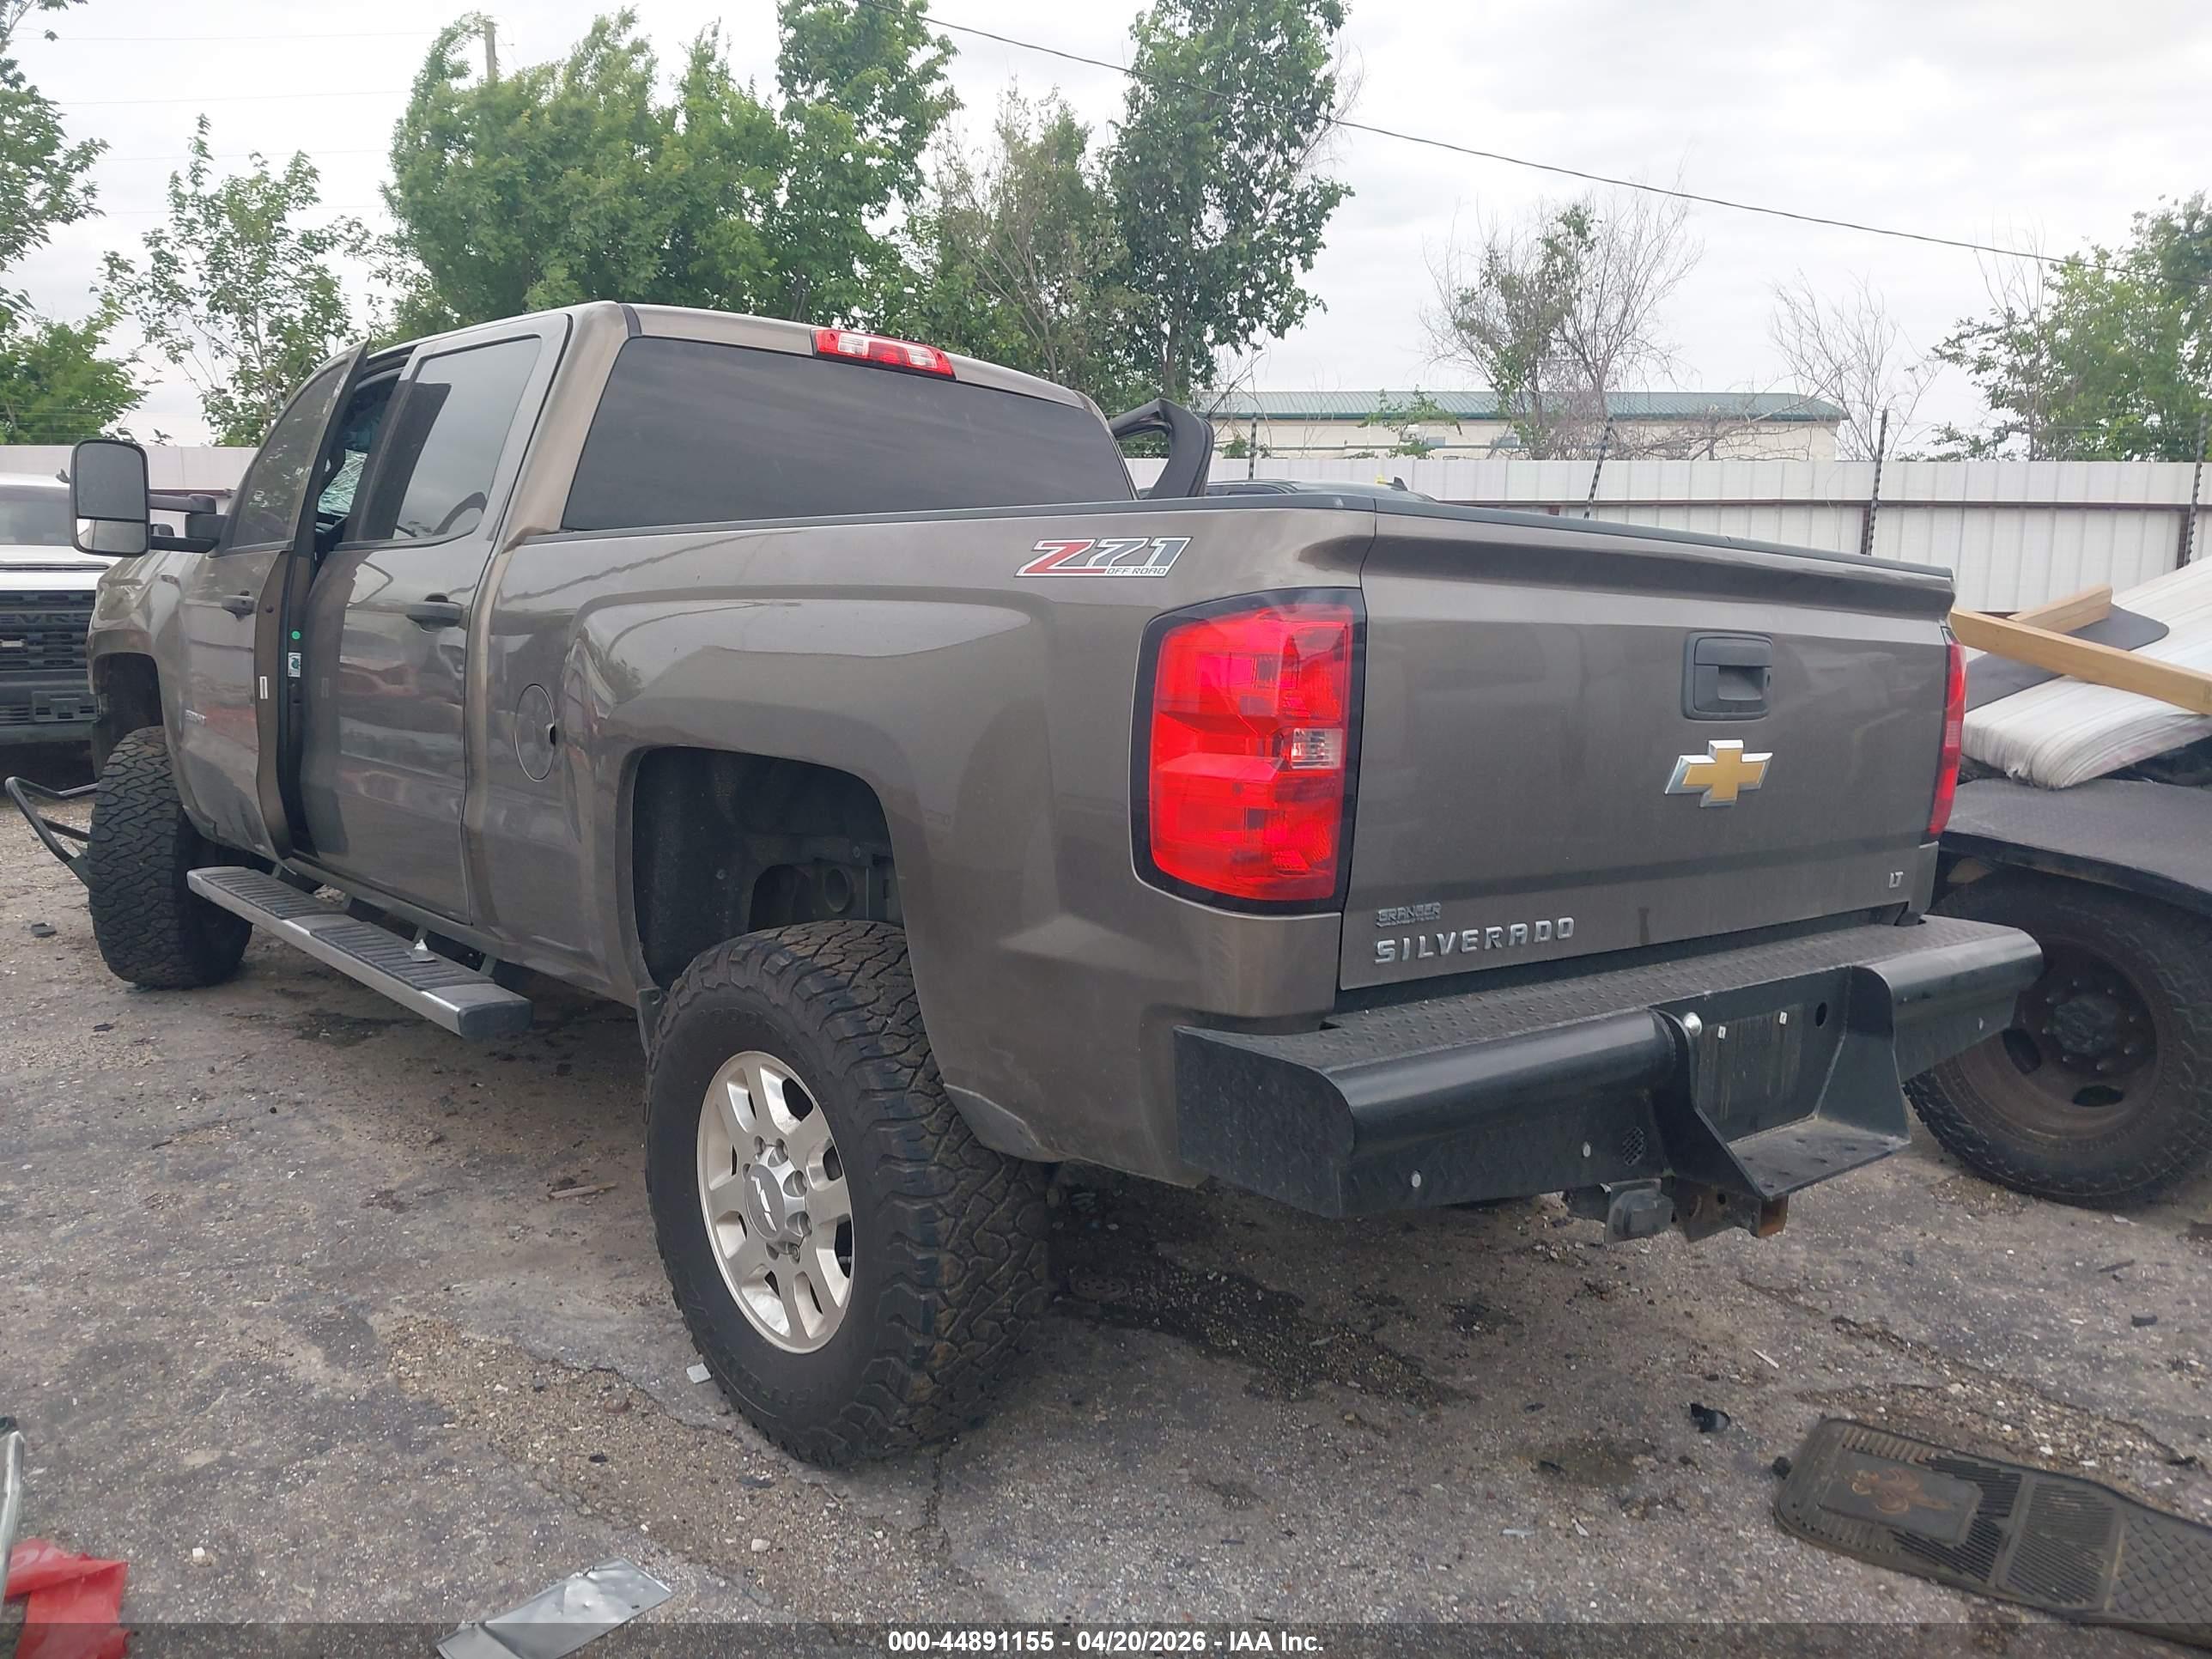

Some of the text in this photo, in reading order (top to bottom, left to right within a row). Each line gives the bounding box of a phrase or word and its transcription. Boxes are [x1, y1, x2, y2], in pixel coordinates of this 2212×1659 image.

[1014, 537, 1194, 577] Z71
[1107, 567, 1167, 575] OFF ROAD
[1888, 871, 1904, 888] LT
[1375, 916, 1575, 965] SILVERADO
